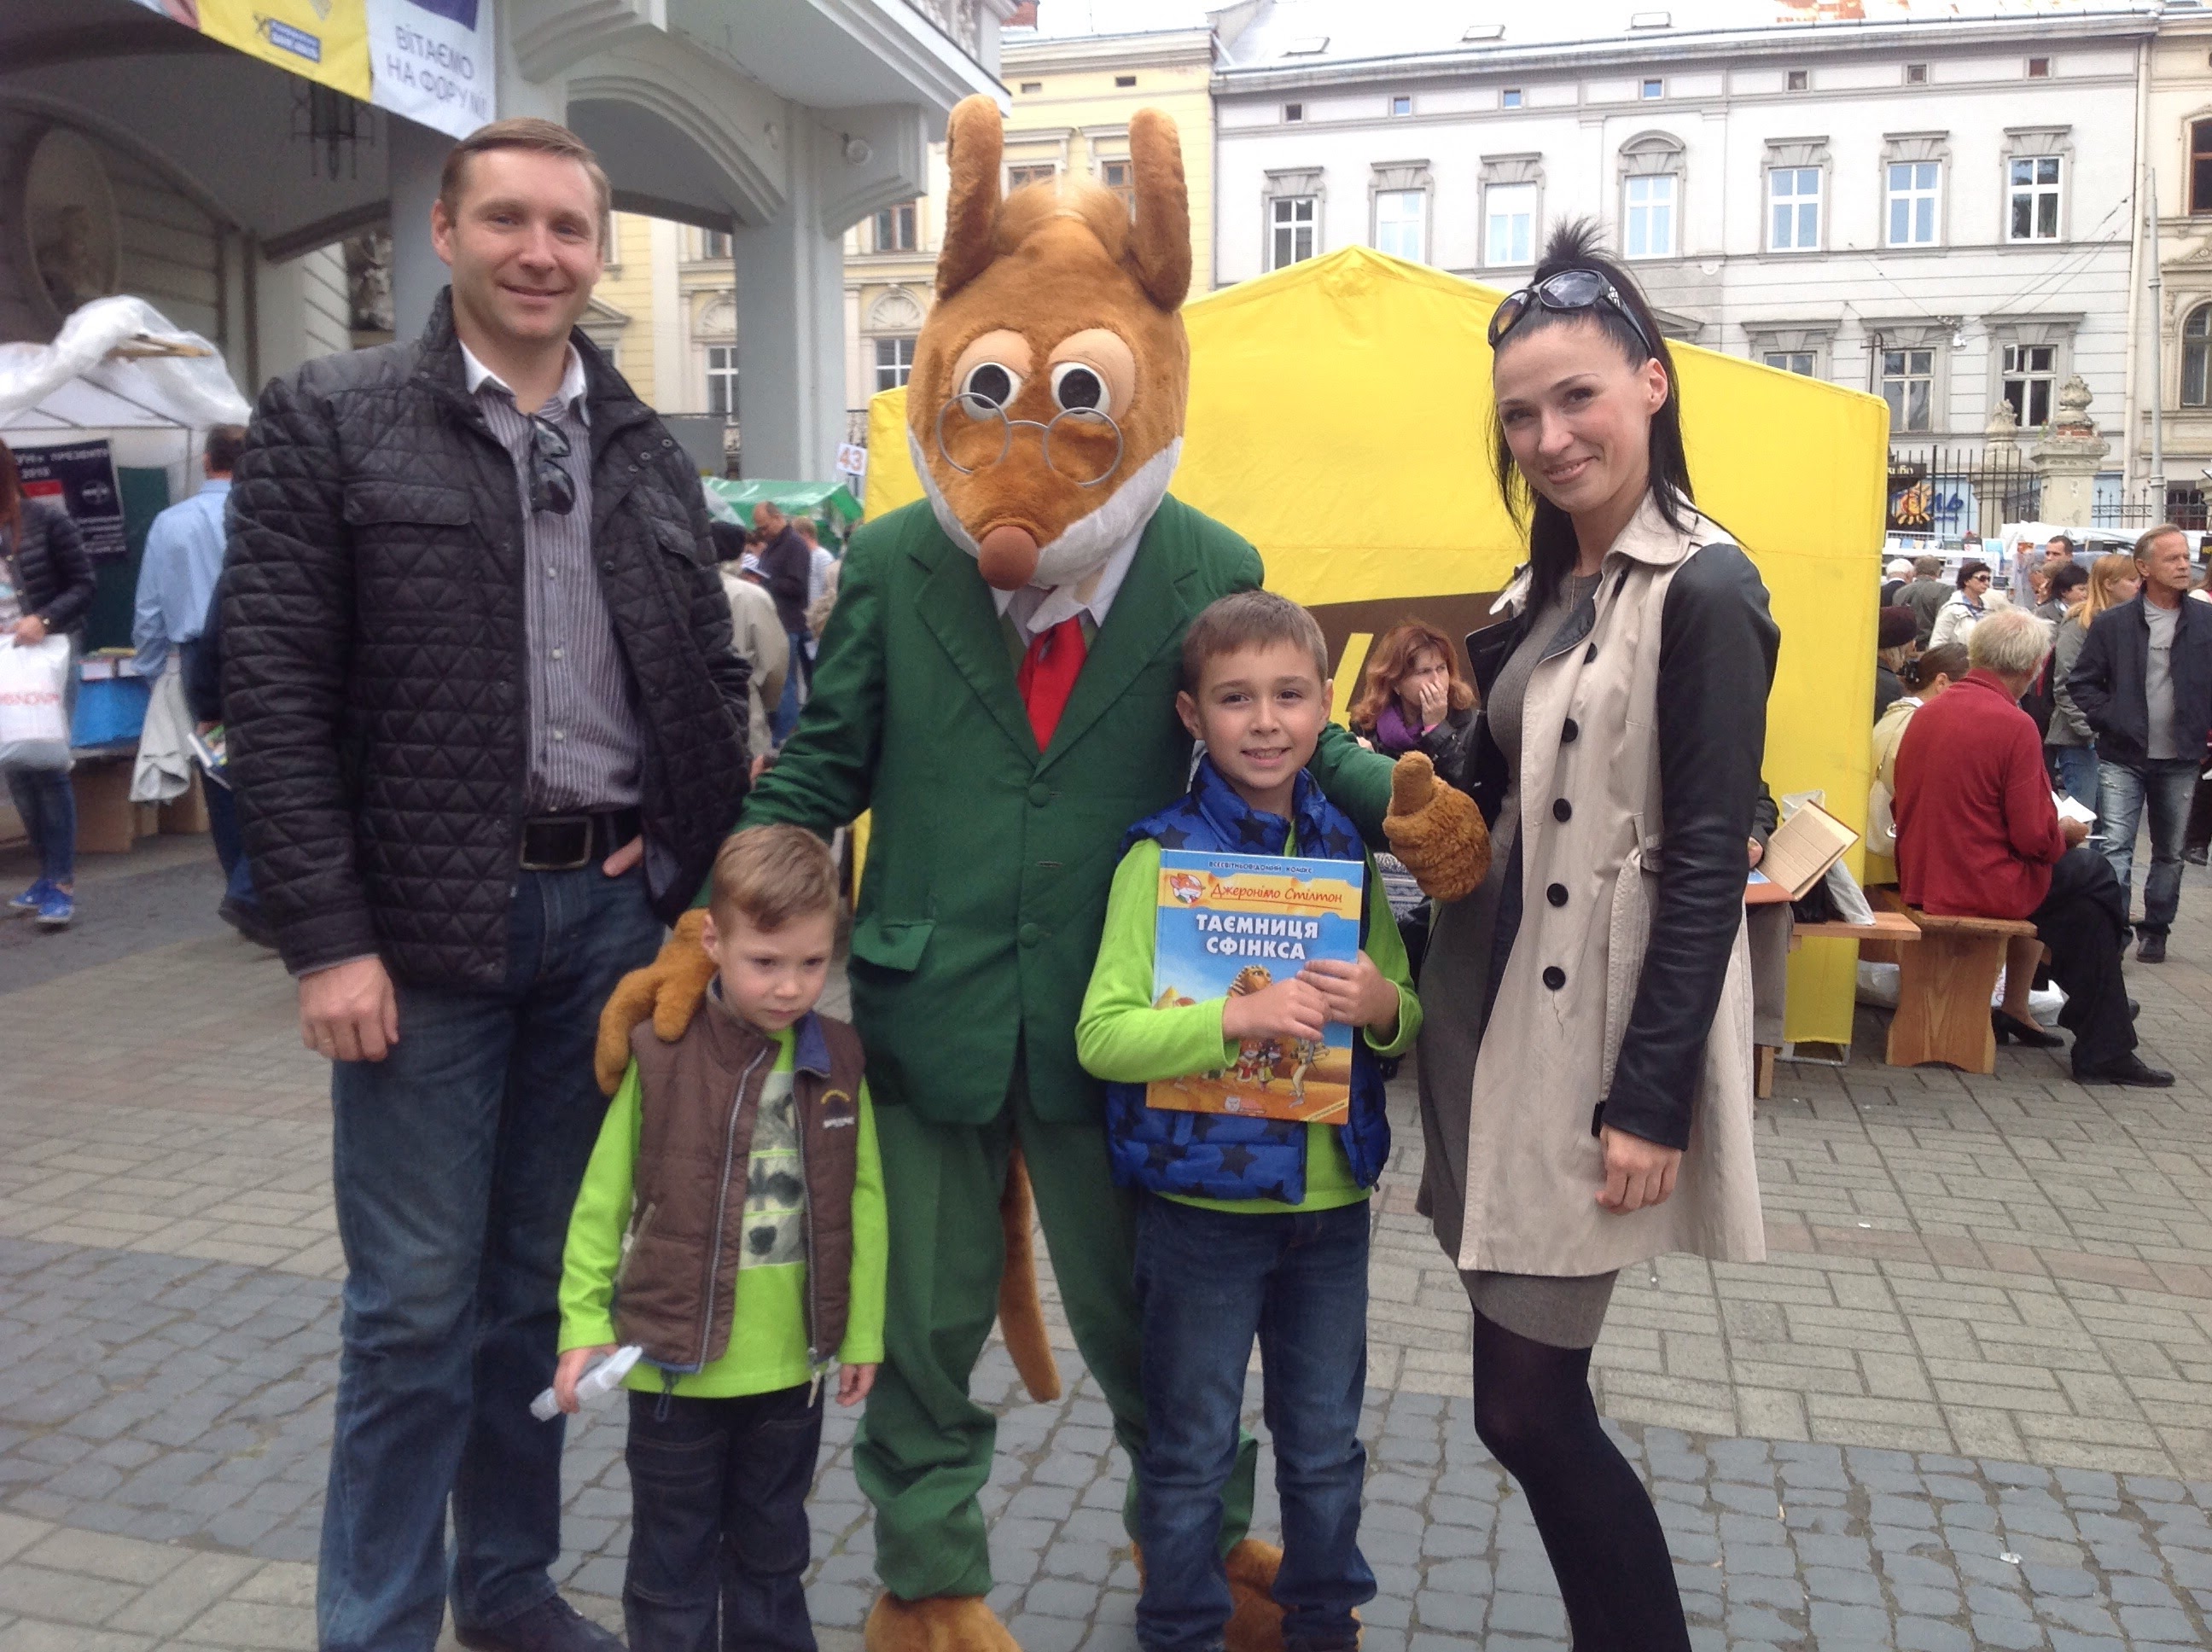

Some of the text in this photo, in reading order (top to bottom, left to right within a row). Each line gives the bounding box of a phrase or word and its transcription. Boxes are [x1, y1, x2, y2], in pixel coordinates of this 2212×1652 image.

[386, 54, 416, 88] НА
[840, 446, 863, 471] 43
[1211, 883, 1342, 904] Джеронімо Стілтон
[1196, 913, 1318, 939] ТАЄМНИЦЯ
[1206, 935, 1306, 960] СФІНКСА
